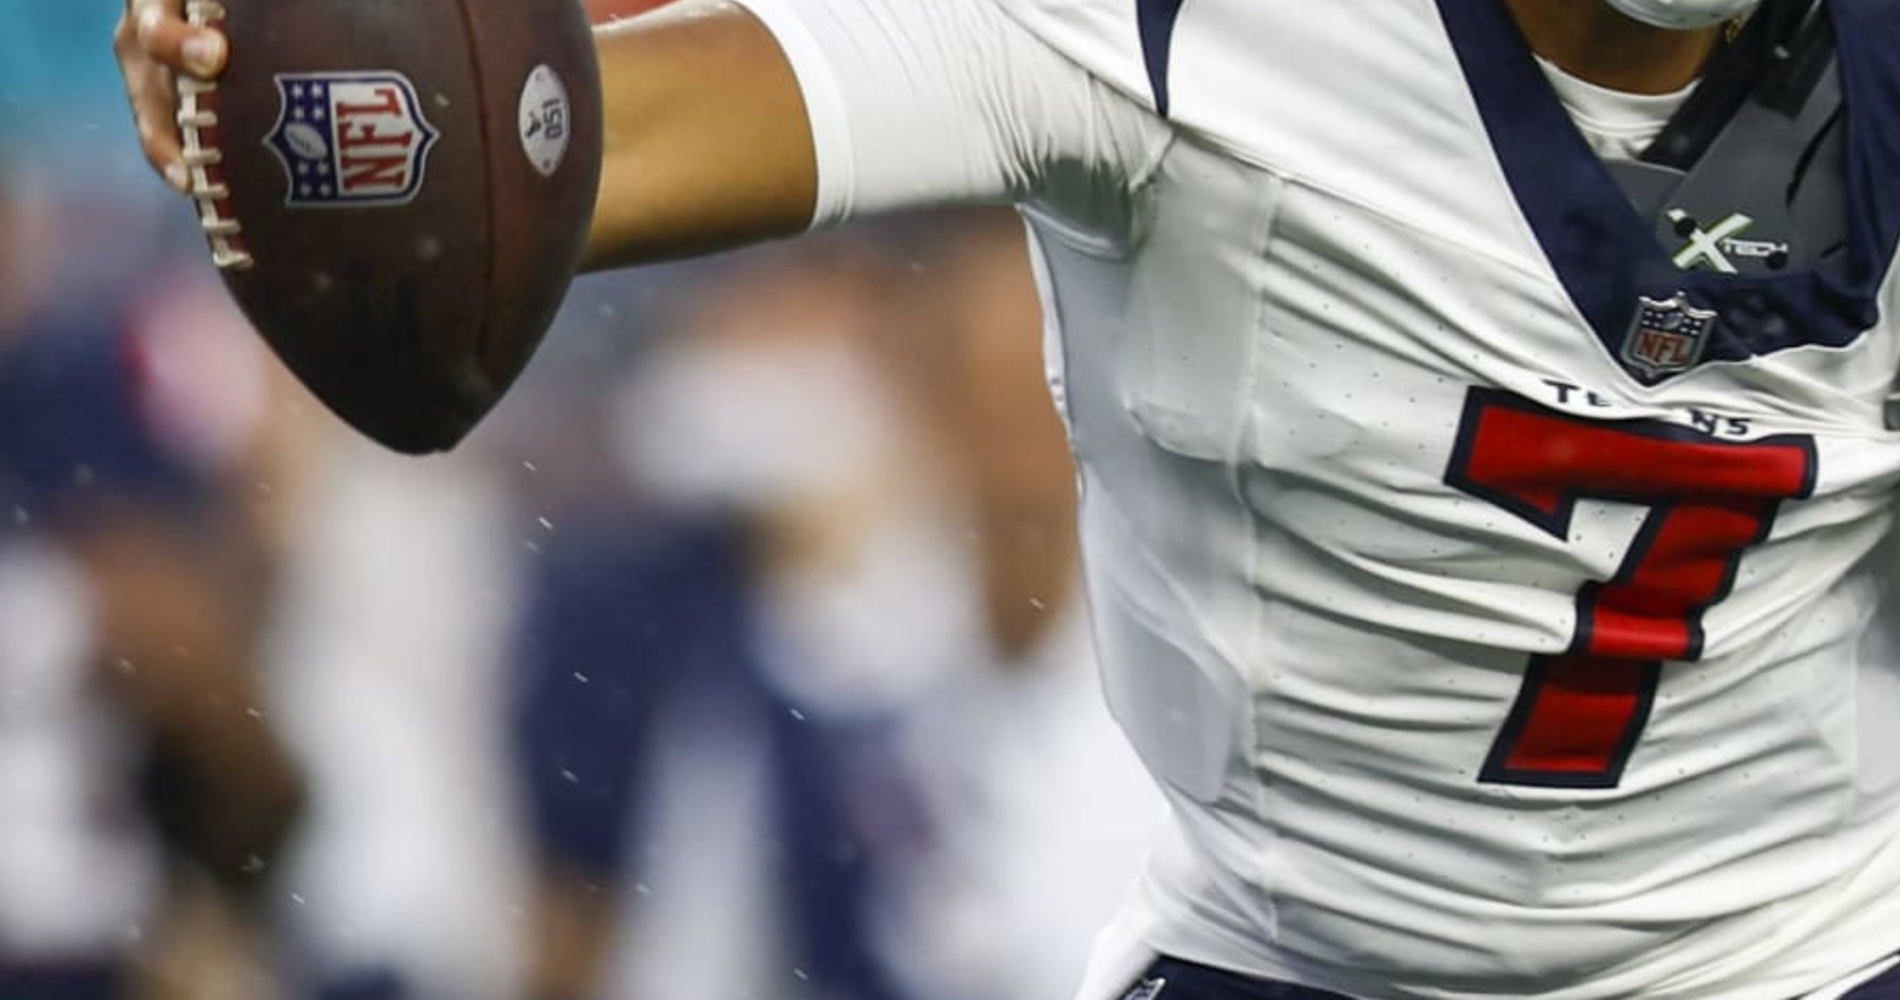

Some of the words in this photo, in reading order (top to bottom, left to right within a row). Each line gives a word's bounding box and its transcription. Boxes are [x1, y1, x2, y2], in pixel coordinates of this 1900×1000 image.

[336, 87, 413, 191] NFL
[541, 97, 563, 139] 051
[1636, 331, 1688, 363] NFL
[1444, 384, 1820, 790] 7
